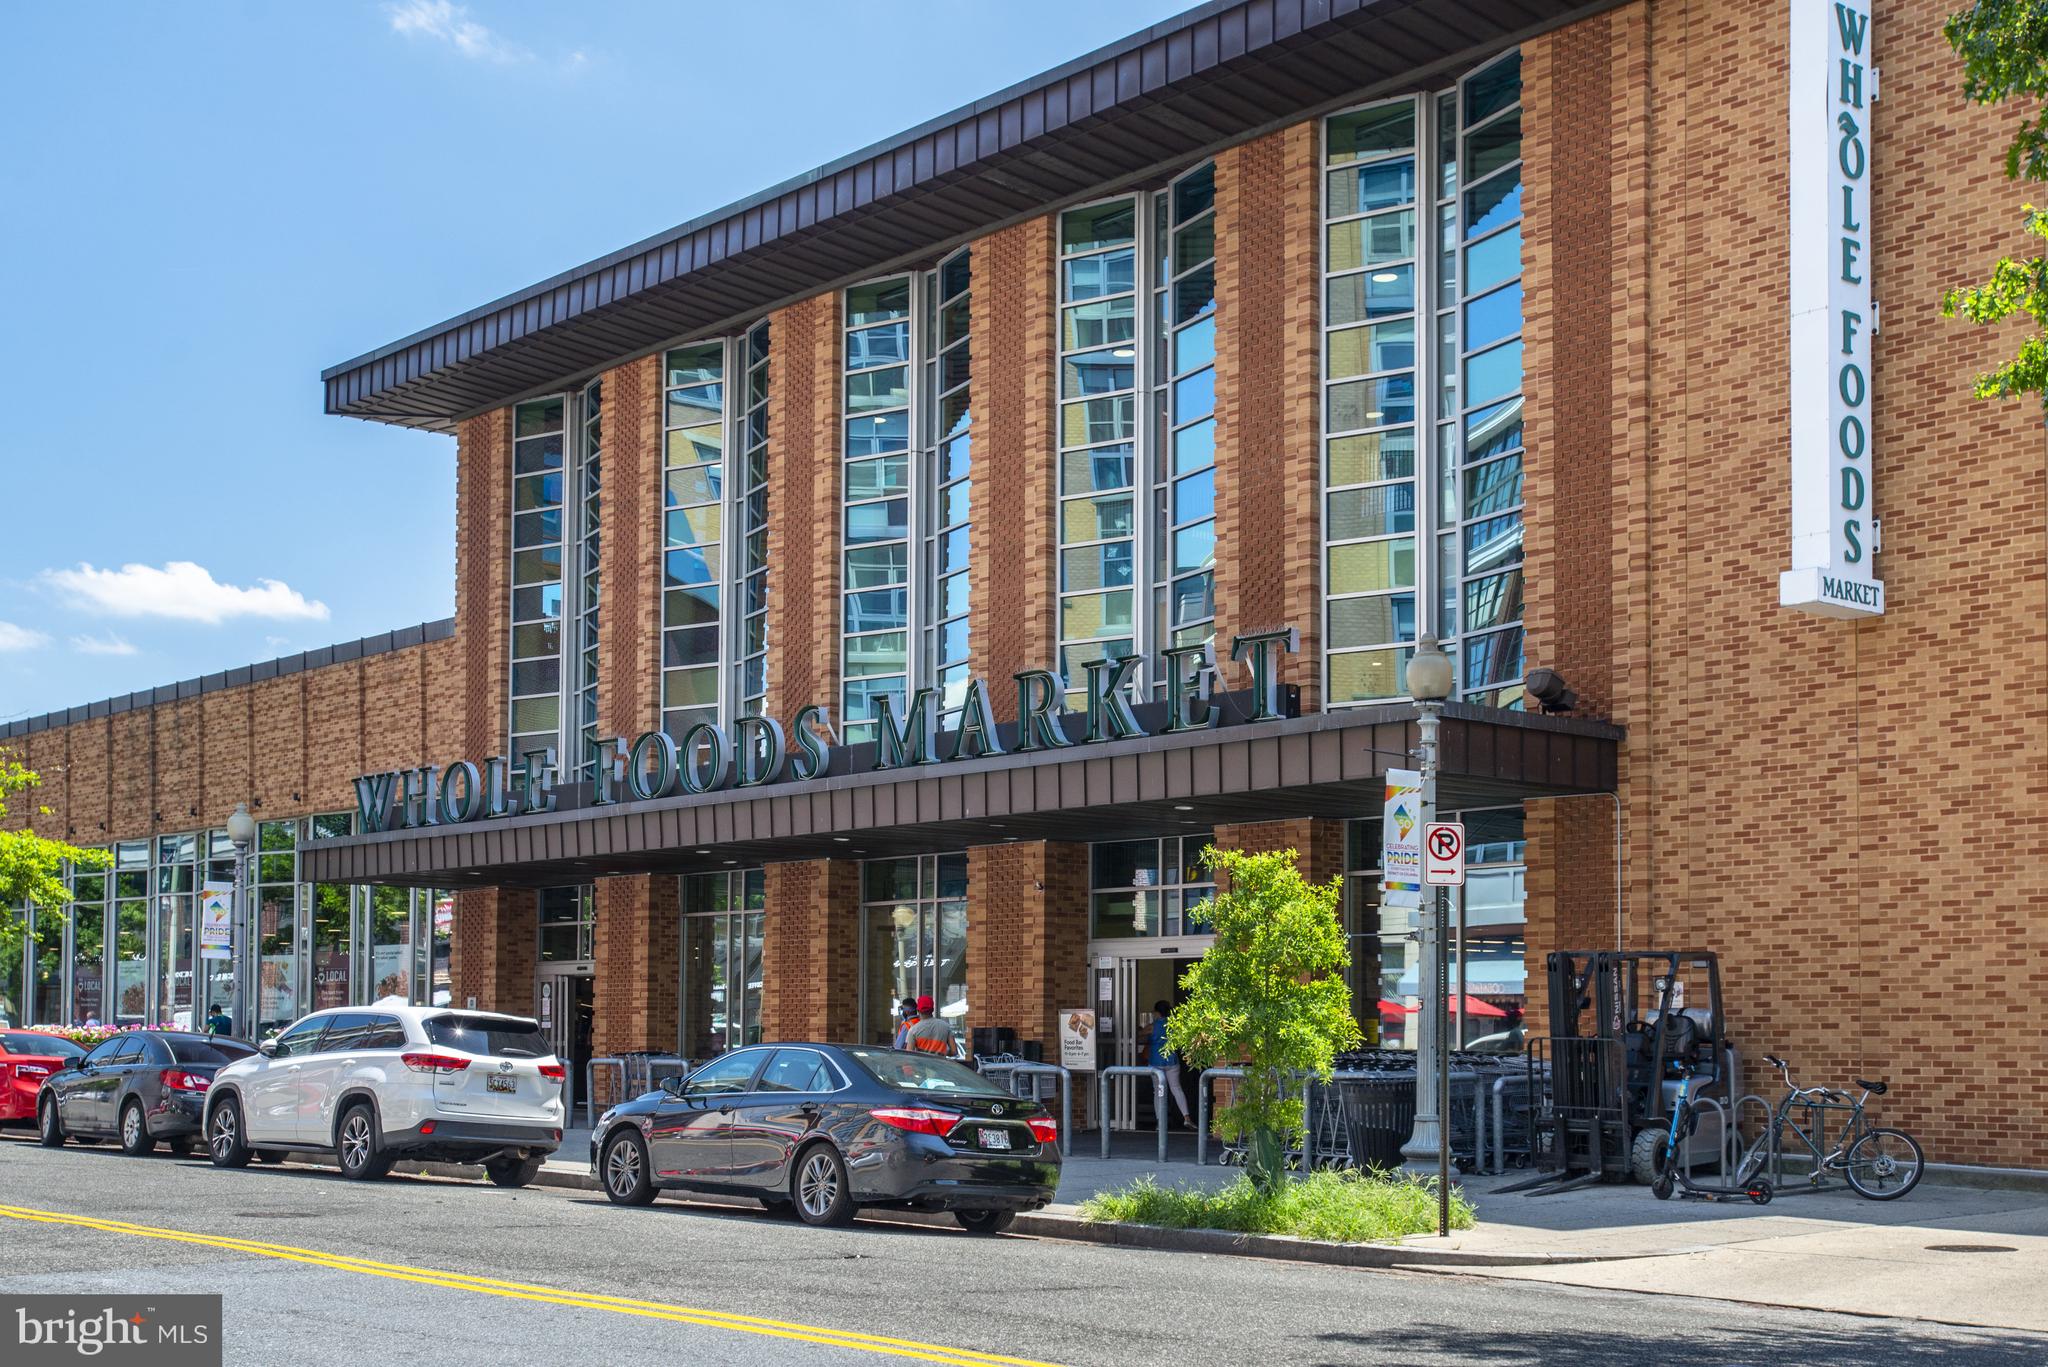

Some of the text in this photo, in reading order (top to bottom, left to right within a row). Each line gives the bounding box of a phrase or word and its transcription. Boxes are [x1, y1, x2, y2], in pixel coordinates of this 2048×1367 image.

[1834, 2, 1869, 564] WHOLE FOODS
[1822, 575, 1880, 608] MARKET
[351, 627, 1300, 834] WHOLE FOODS MARKET
[1385, 843, 1419, 851] CELEBRATING
[1387, 851, 1419, 865] PRIDE
[204, 927, 230, 936] PRIDE
[326, 970, 348, 982] LOCAL
